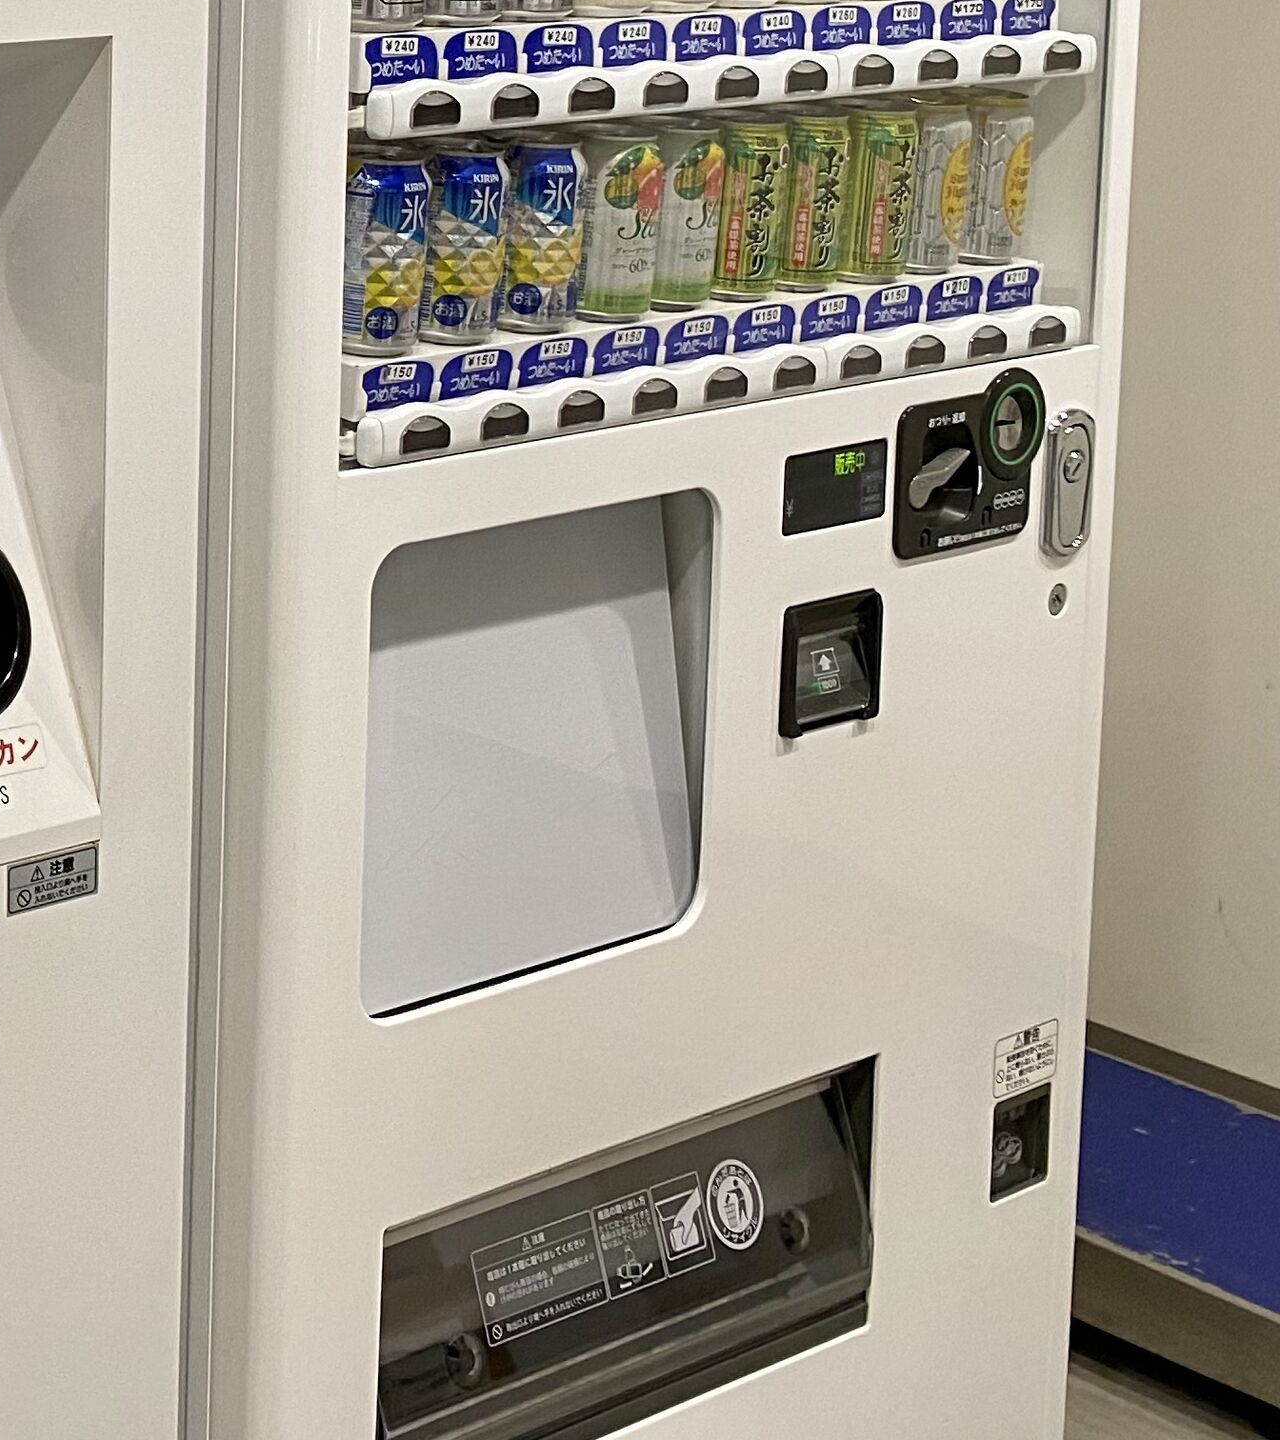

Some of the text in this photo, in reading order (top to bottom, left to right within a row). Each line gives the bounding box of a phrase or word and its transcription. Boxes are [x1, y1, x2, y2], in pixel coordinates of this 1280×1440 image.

[955, 4, 983, 14] ¥170
[694, 21, 718, 33] ¥240
[386, 40, 415, 52] ¥240
[547, 165, 573, 174] KIRIN
[544, 342, 570, 354] ¥150
[833, 452, 866, 476] 販売中
[49, 857, 74, 876] 注意
